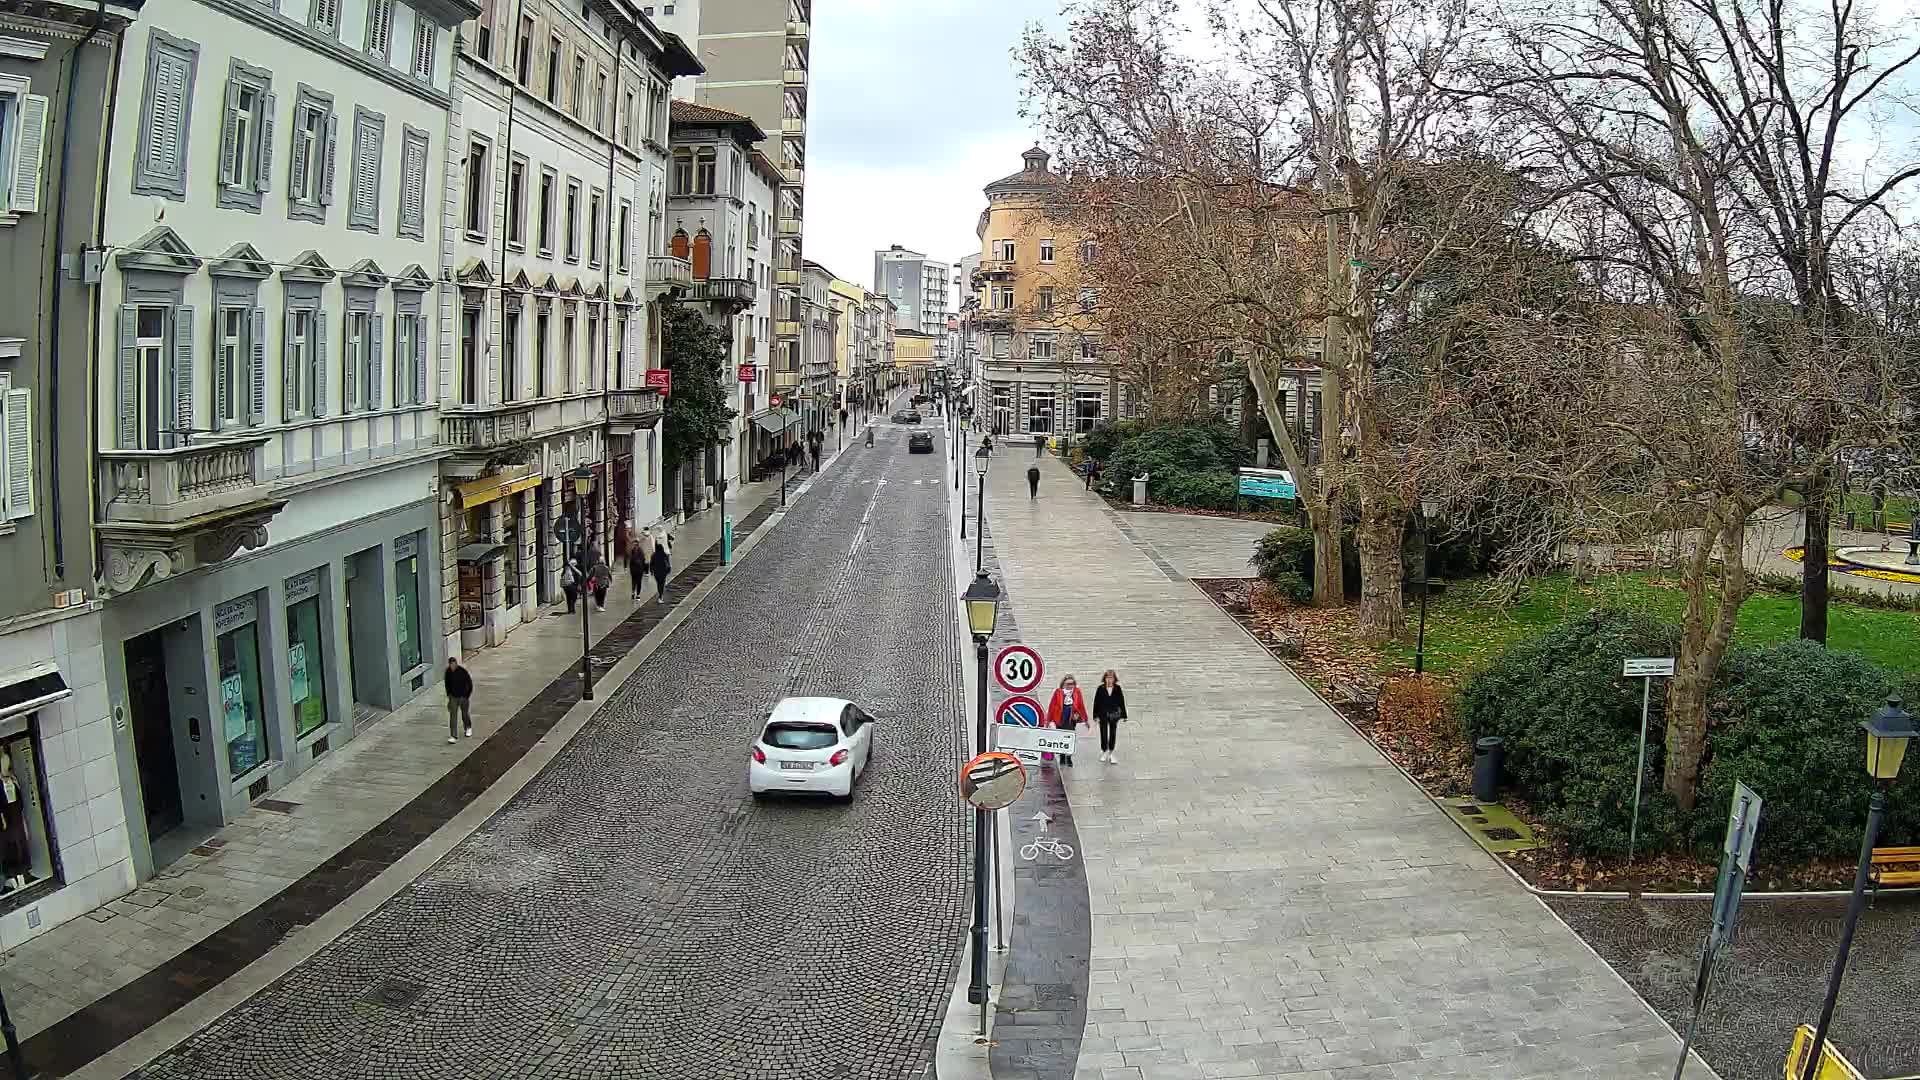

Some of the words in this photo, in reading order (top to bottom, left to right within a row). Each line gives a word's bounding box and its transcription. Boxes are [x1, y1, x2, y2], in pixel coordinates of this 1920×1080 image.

[1006, 658, 1033, 681] 30
[223, 678, 241, 700] 130
[1038, 738, 1070, 749] Dante
